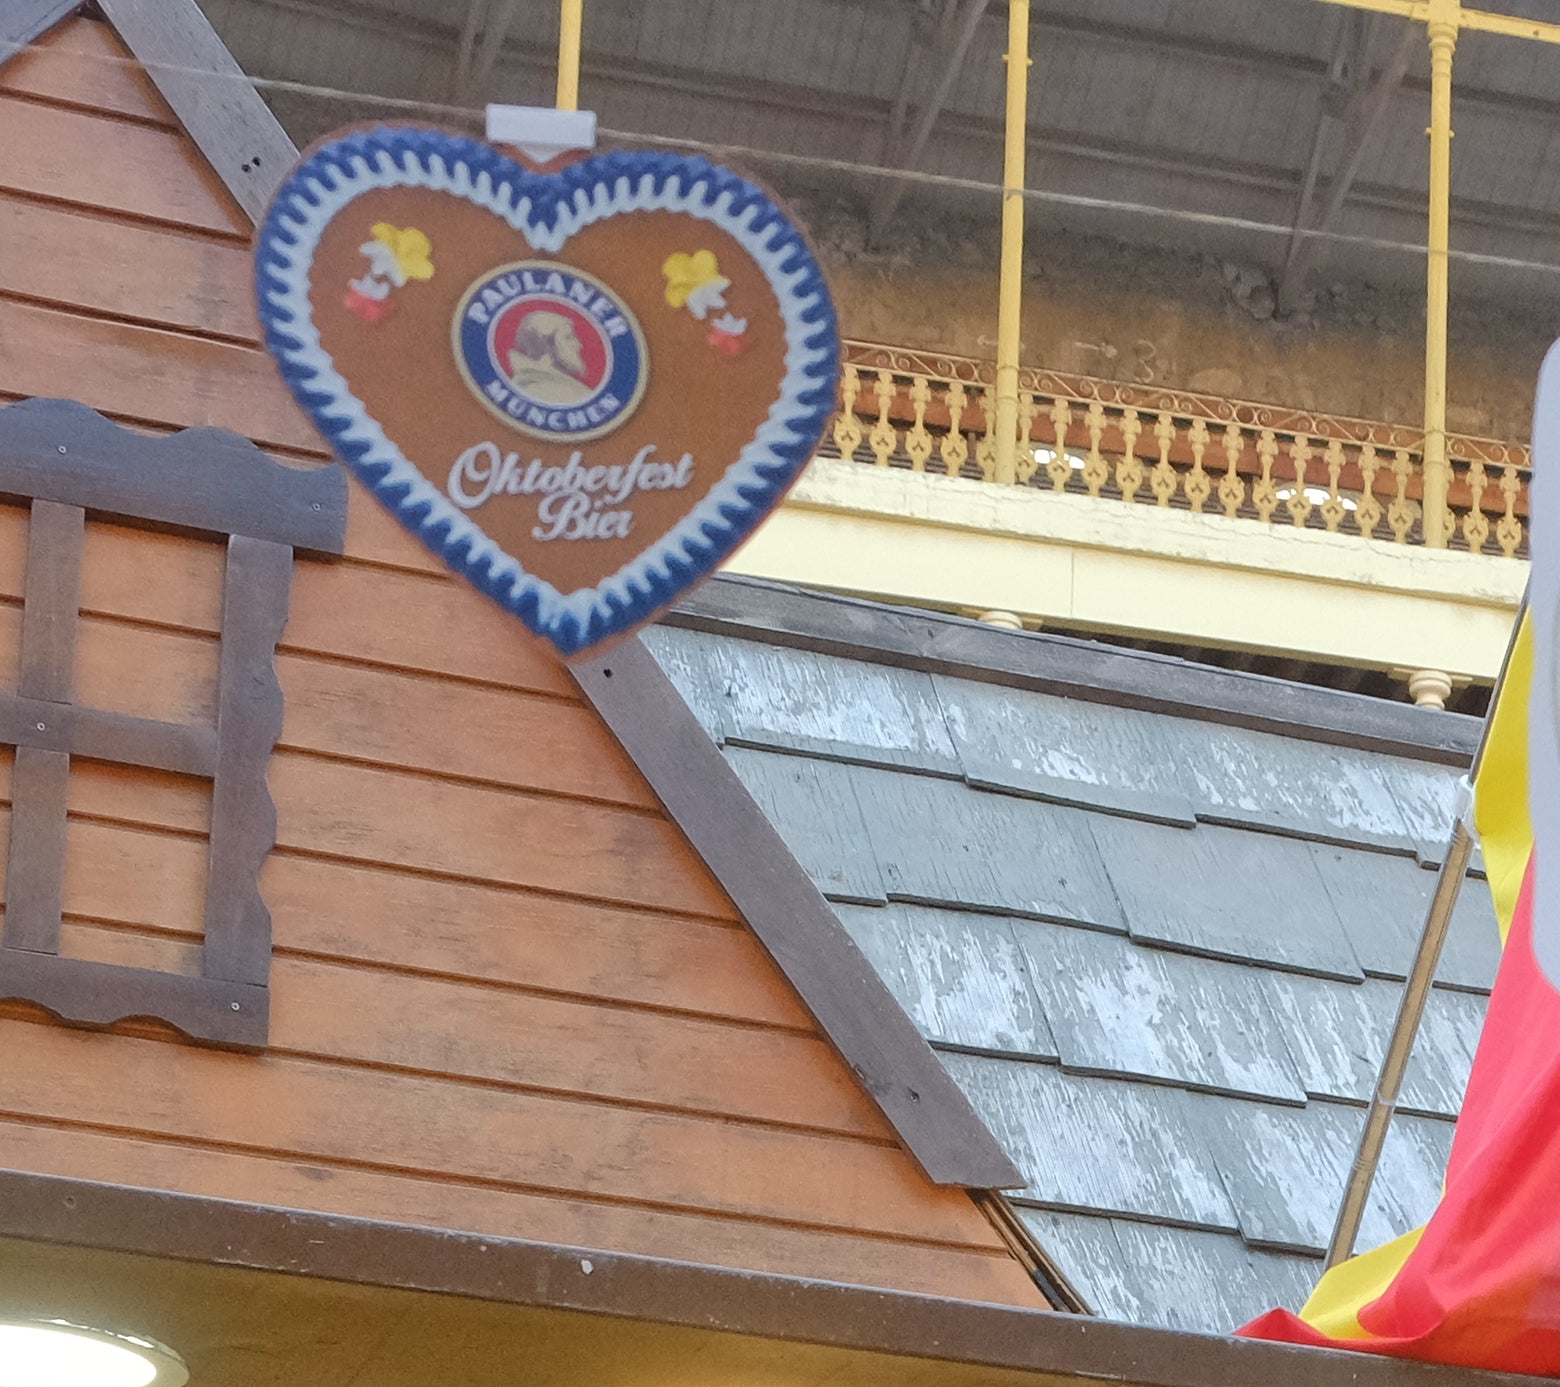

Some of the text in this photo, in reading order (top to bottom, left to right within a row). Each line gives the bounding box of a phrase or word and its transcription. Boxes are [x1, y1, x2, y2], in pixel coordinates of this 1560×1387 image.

[467, 271, 629, 338] PAULANER
[446, 440, 696, 510] Oktoberfest
[530, 490, 637, 542] Bier
